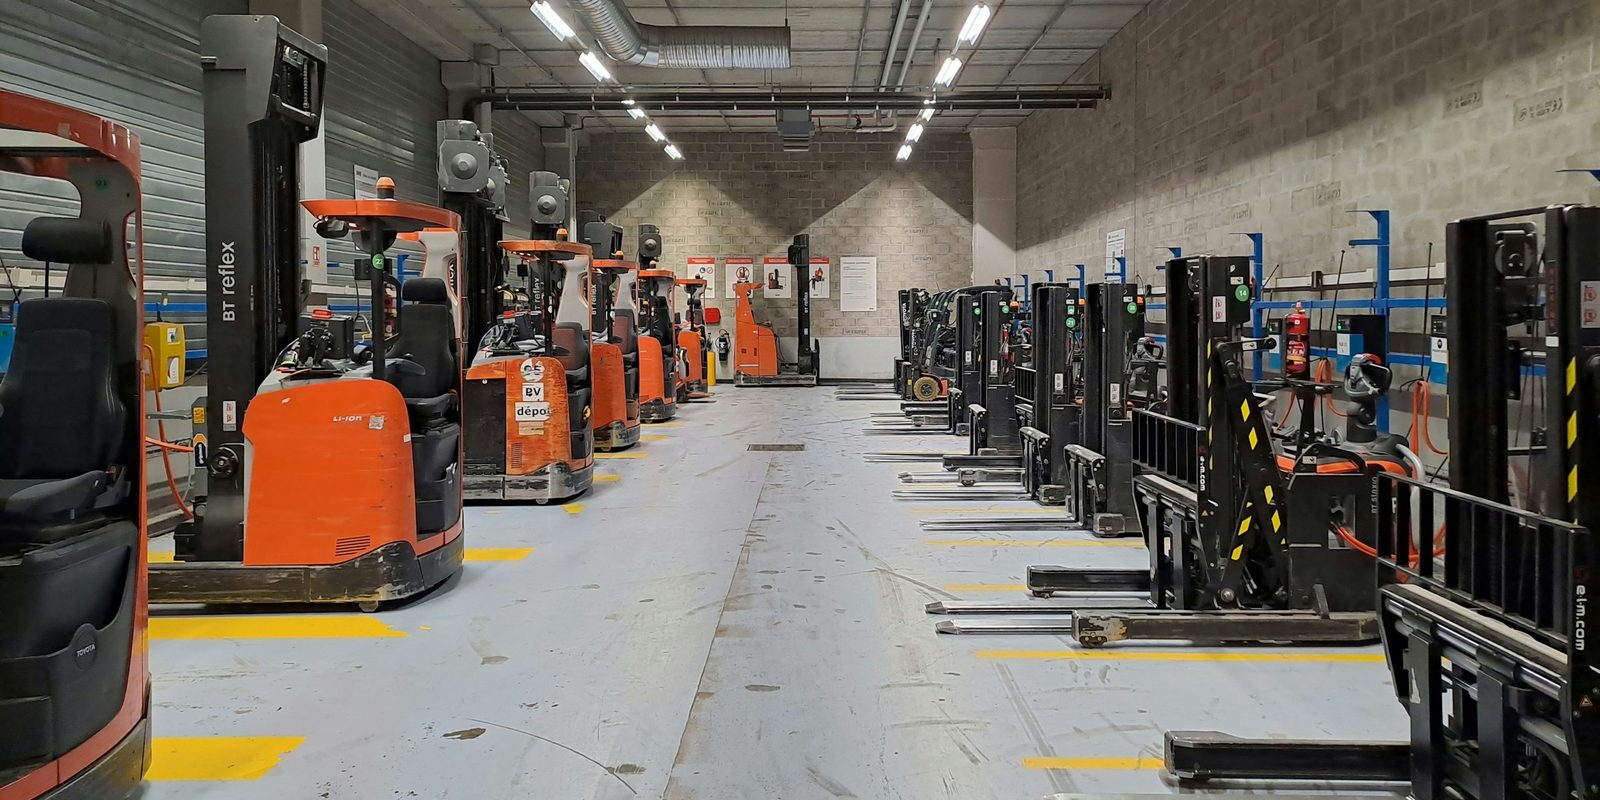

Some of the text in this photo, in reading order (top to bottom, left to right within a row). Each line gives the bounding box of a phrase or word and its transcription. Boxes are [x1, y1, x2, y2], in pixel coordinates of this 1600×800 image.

[218, 241, 235, 321] BT reflex
[1372, 504, 1377, 514] BT
[76, 644, 96, 656] TOYOTA
